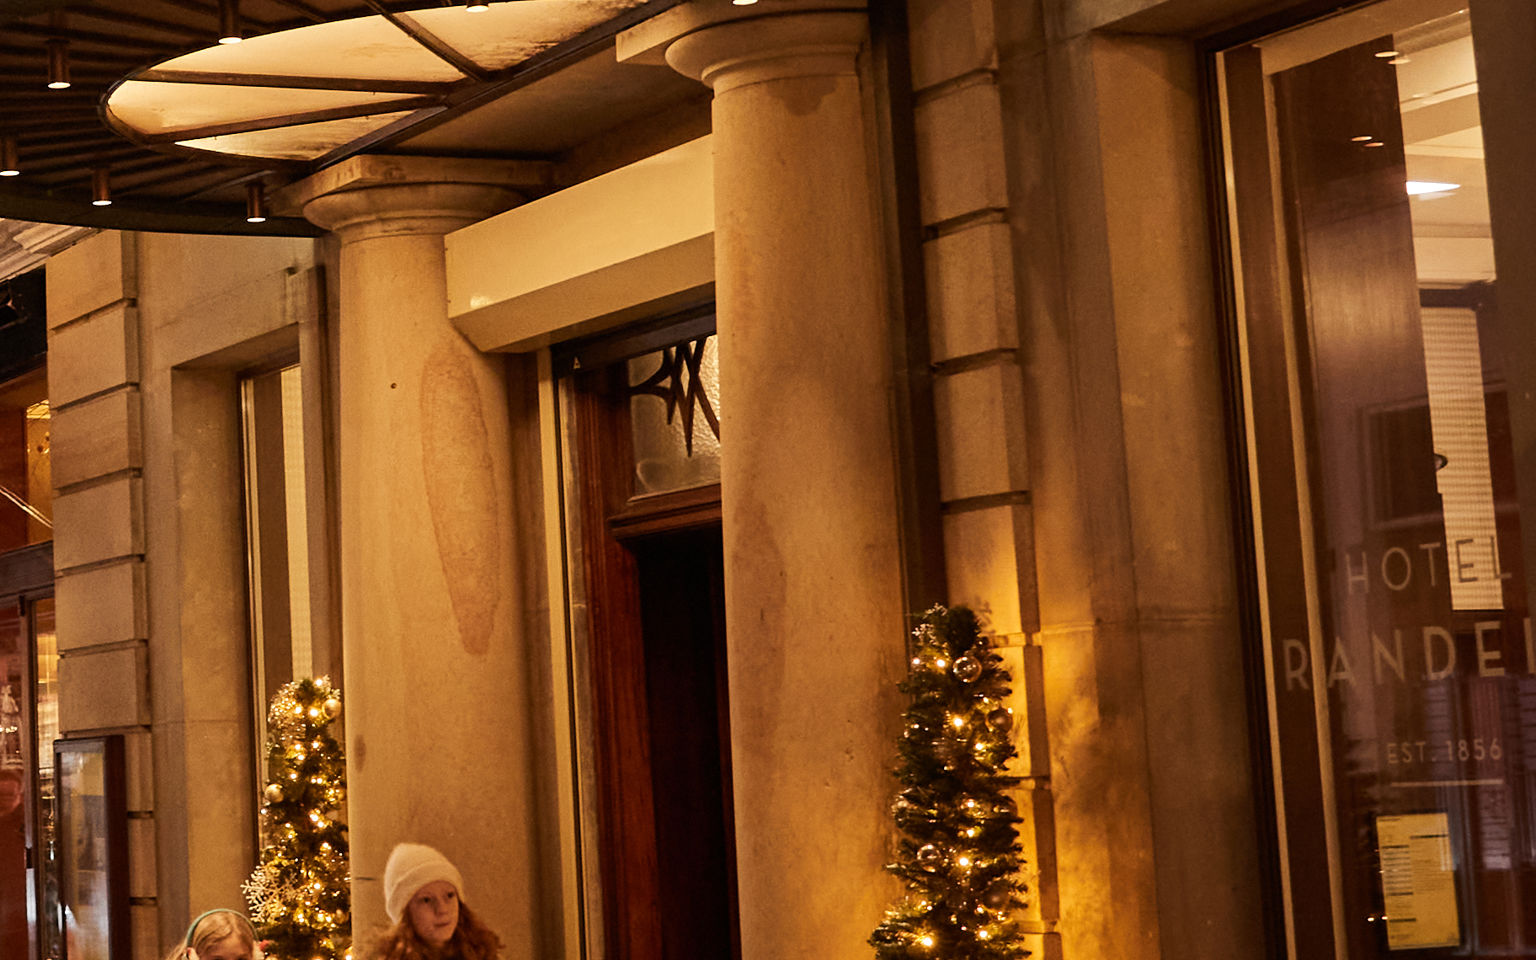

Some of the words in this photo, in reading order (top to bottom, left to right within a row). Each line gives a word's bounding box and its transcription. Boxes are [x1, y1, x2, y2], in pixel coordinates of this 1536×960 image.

[1345, 535, 1512, 595] HOTEL
[1387, 741, 1437, 765] EST.
[1445, 737, 1503, 762] 1856
